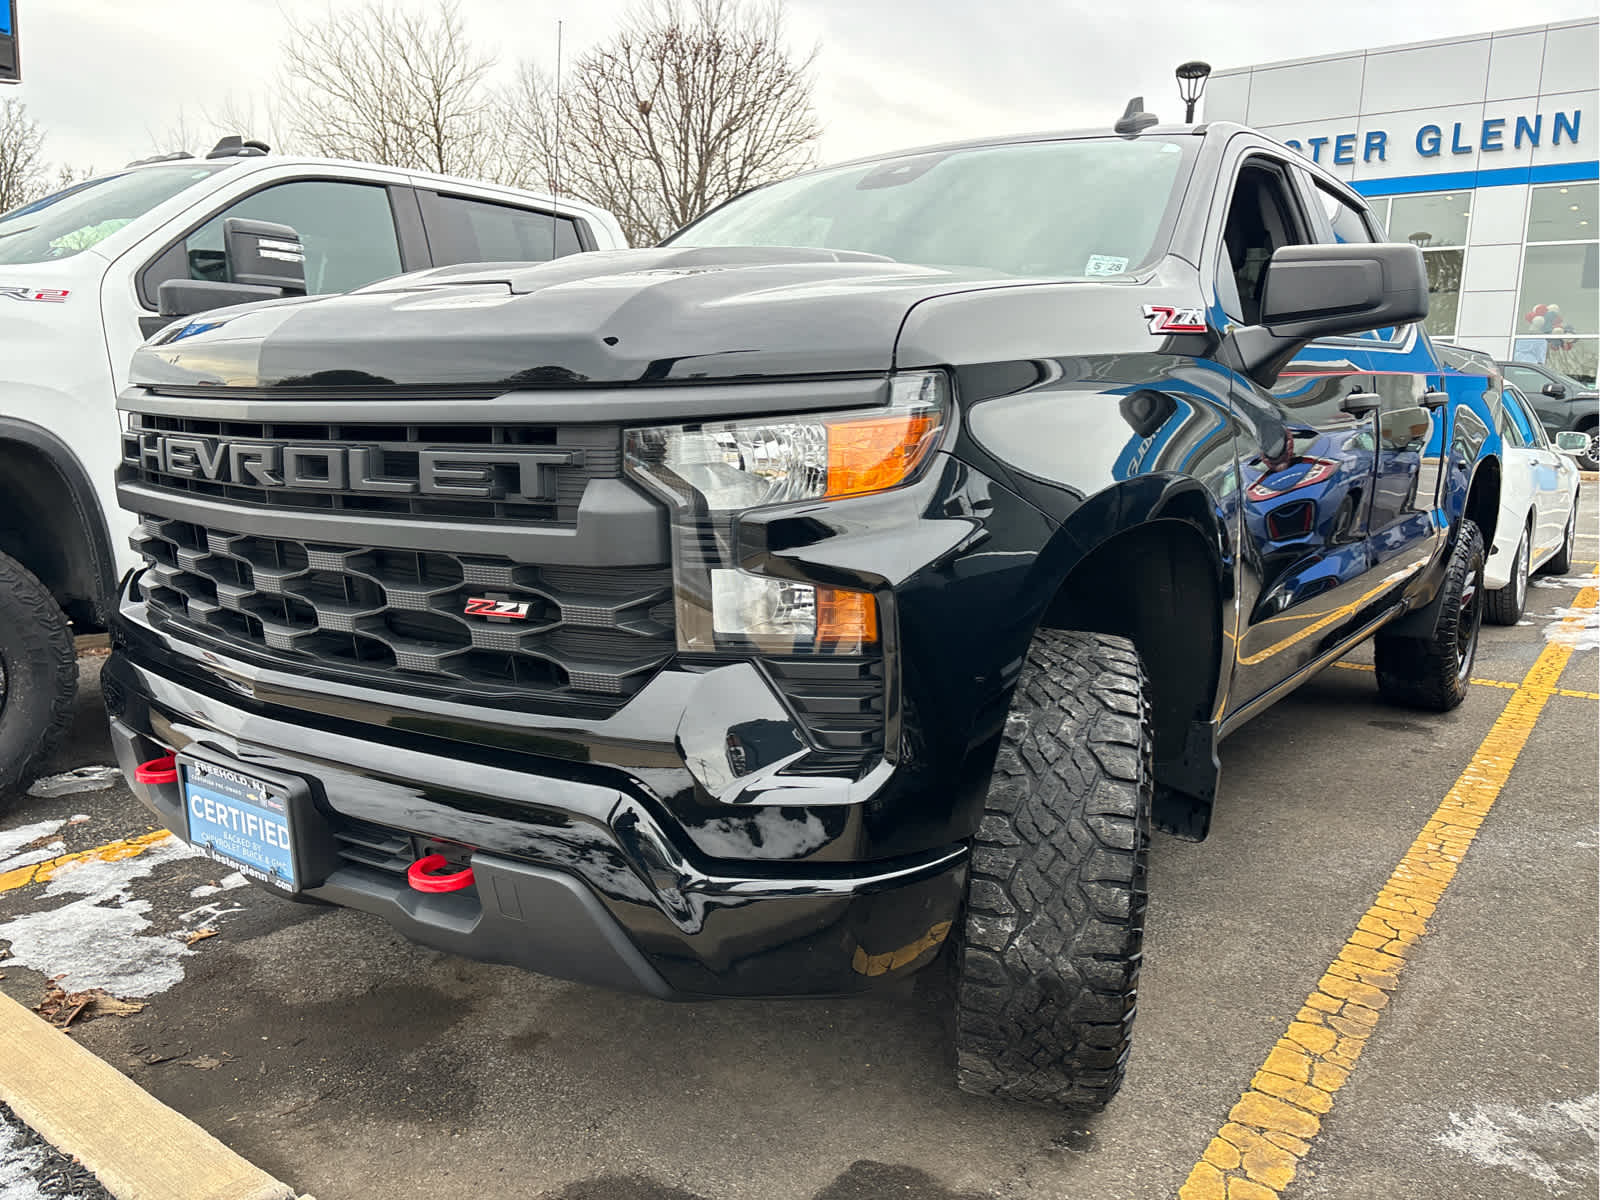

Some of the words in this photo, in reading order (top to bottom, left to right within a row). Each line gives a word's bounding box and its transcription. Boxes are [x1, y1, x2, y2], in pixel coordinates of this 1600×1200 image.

[1415, 109, 1582, 159] GLENN
[122, 431, 580, 499] CHEVROLET
[464, 598, 530, 619] Z71
[191, 795, 289, 850] CERTIFIED
[223, 831, 251, 847] BACKED
[242, 847, 264, 862] BUICK
